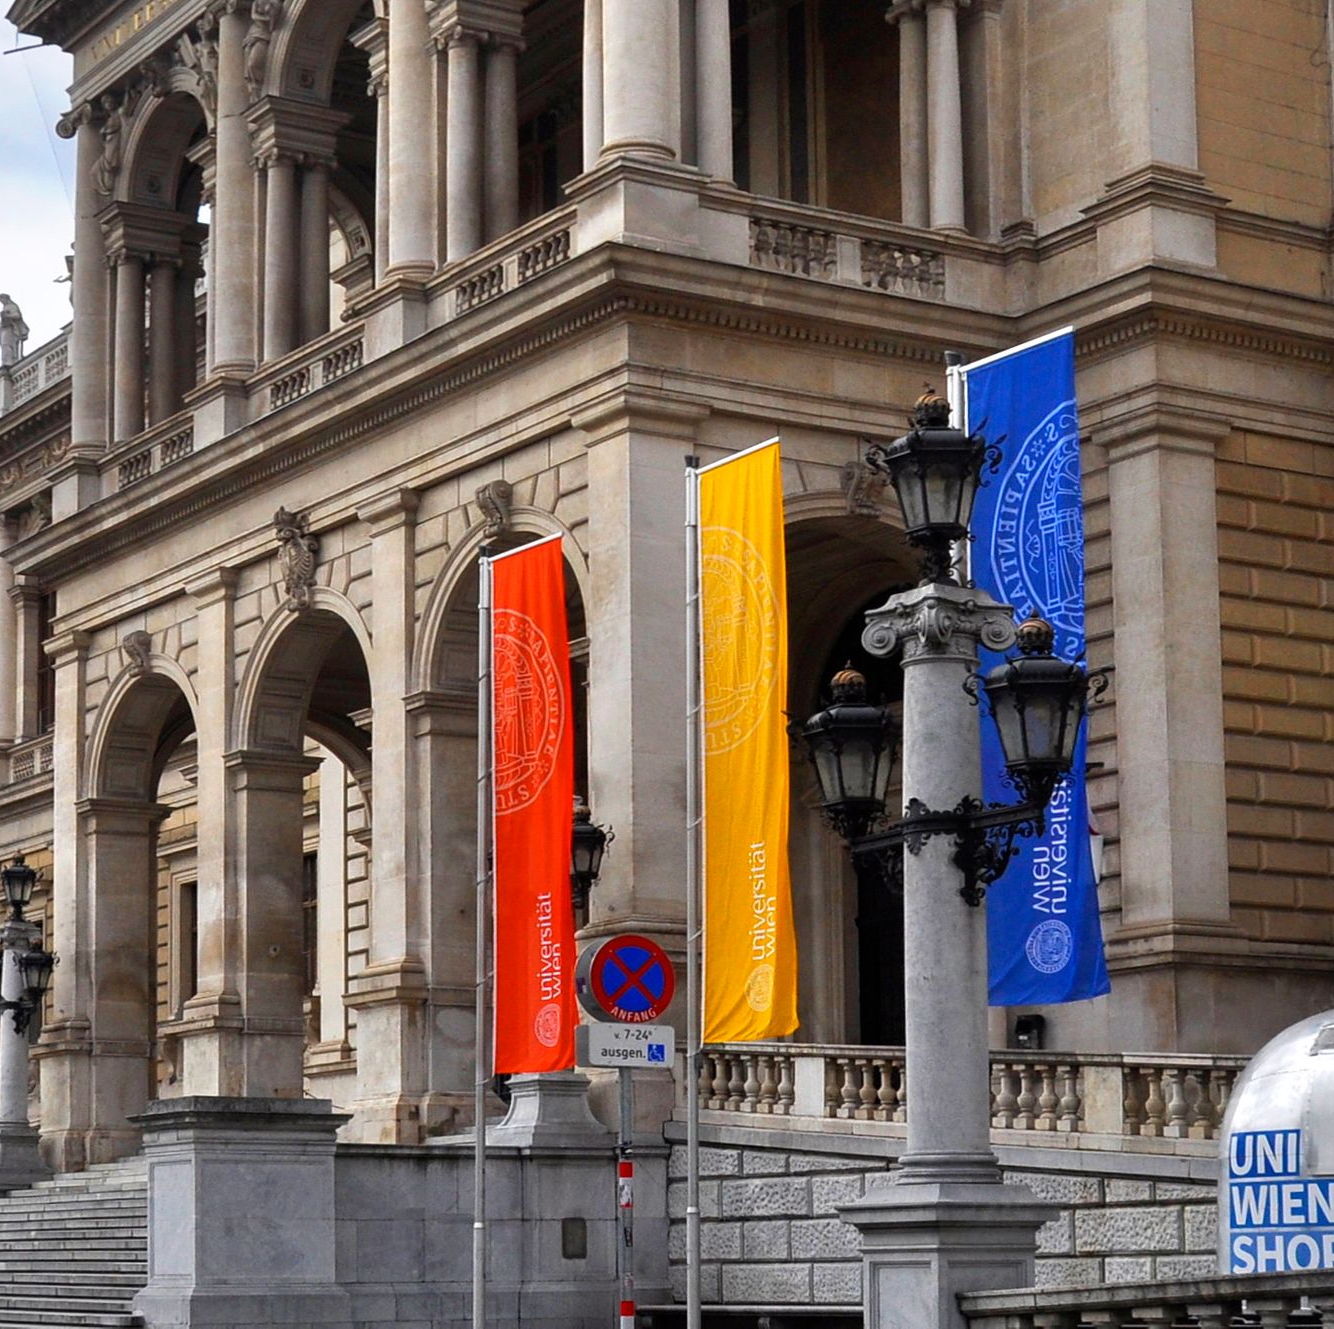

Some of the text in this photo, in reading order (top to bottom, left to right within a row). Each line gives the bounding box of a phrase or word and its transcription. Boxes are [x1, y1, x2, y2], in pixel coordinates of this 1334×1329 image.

[748, 840, 766, 961] universität
[765, 896, 777, 958] wien
[536, 891, 552, 1001] universität
[551, 943, 562, 999] wien
[610, 1005, 657, 1023] ANFANG
[600, 1047, 647, 1060] ausgen.
[1230, 1132, 1298, 1176] UNI
